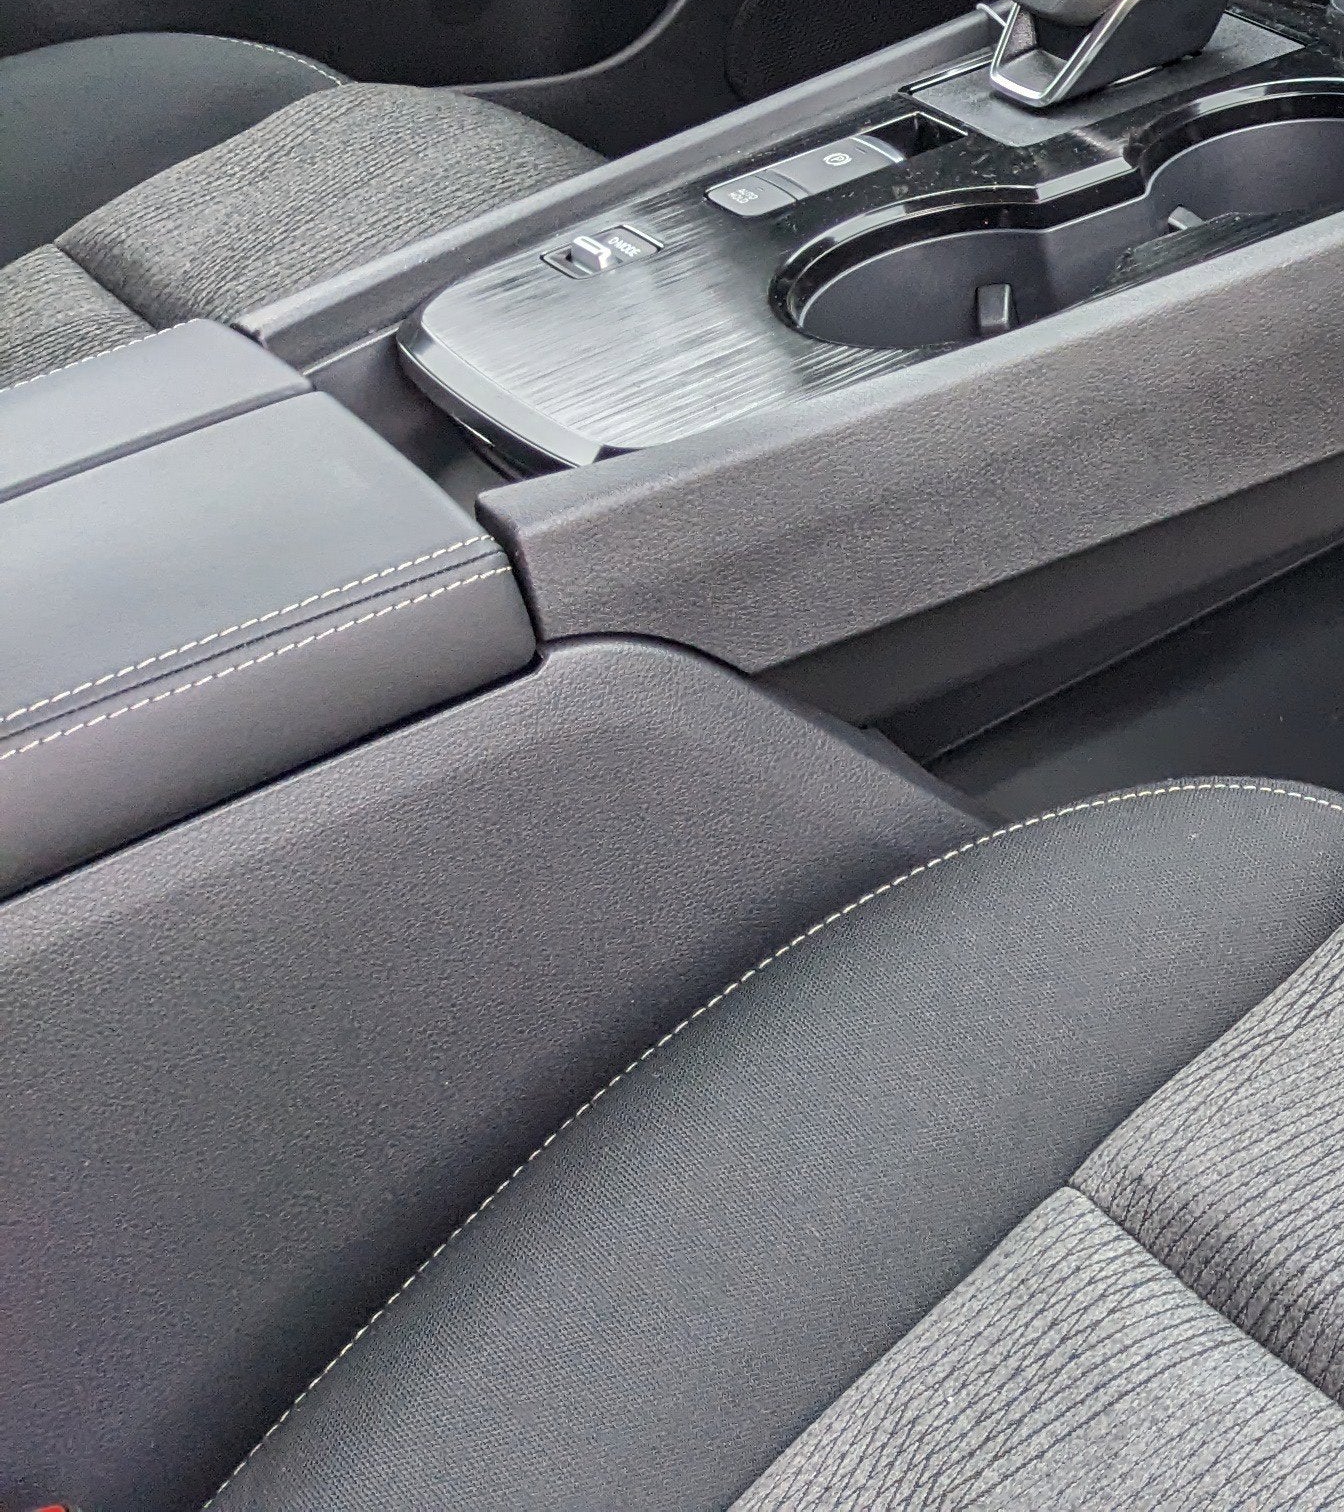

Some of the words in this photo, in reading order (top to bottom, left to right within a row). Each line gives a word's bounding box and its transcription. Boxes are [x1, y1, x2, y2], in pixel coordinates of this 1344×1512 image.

[728, 192, 749, 204] HOLD
[738, 188, 759, 200] AUTO
[608, 236, 641, 257] D-MODE
